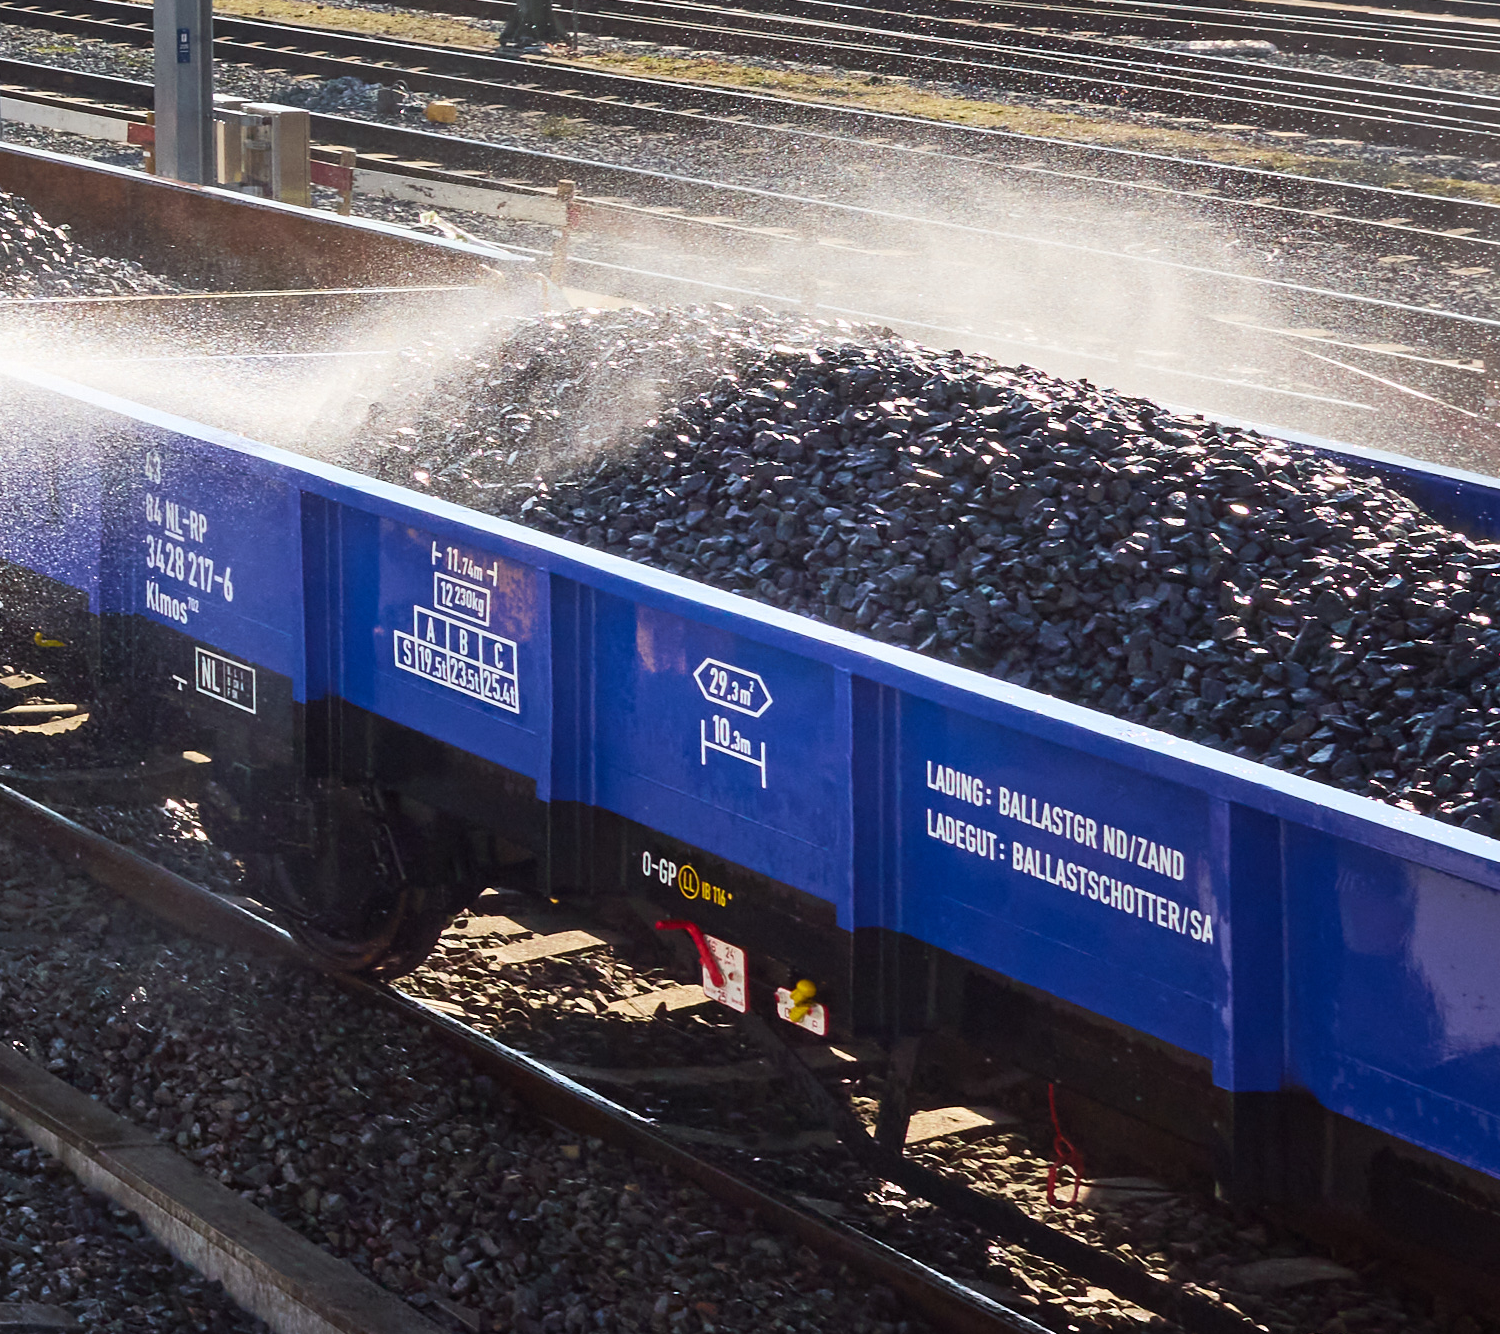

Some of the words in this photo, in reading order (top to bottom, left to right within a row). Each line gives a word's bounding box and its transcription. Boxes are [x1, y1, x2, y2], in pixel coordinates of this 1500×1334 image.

[144, 451, 161, 484] 43
[145, 493, 162, 526] 84
[165, 499, 208, 543] NL-RP
[146, 534, 185, 582] 3428
[188, 551, 234, 602] 217-6
[426, 616, 436, 644] A
[459, 628, 469, 656] B
[494, 642, 504, 669] C
[201, 656, 221, 694] NL
[402, 639, 412, 665] S
[418, 645, 447, 680] 19.5t
[450, 657, 480, 693] 23.5t
[484, 670, 516, 706] 25.4t
[712, 714, 751, 756] 10.3m
[927, 760, 992, 807] LADING:
[927, 808, 1006, 861] LADEGUT:
